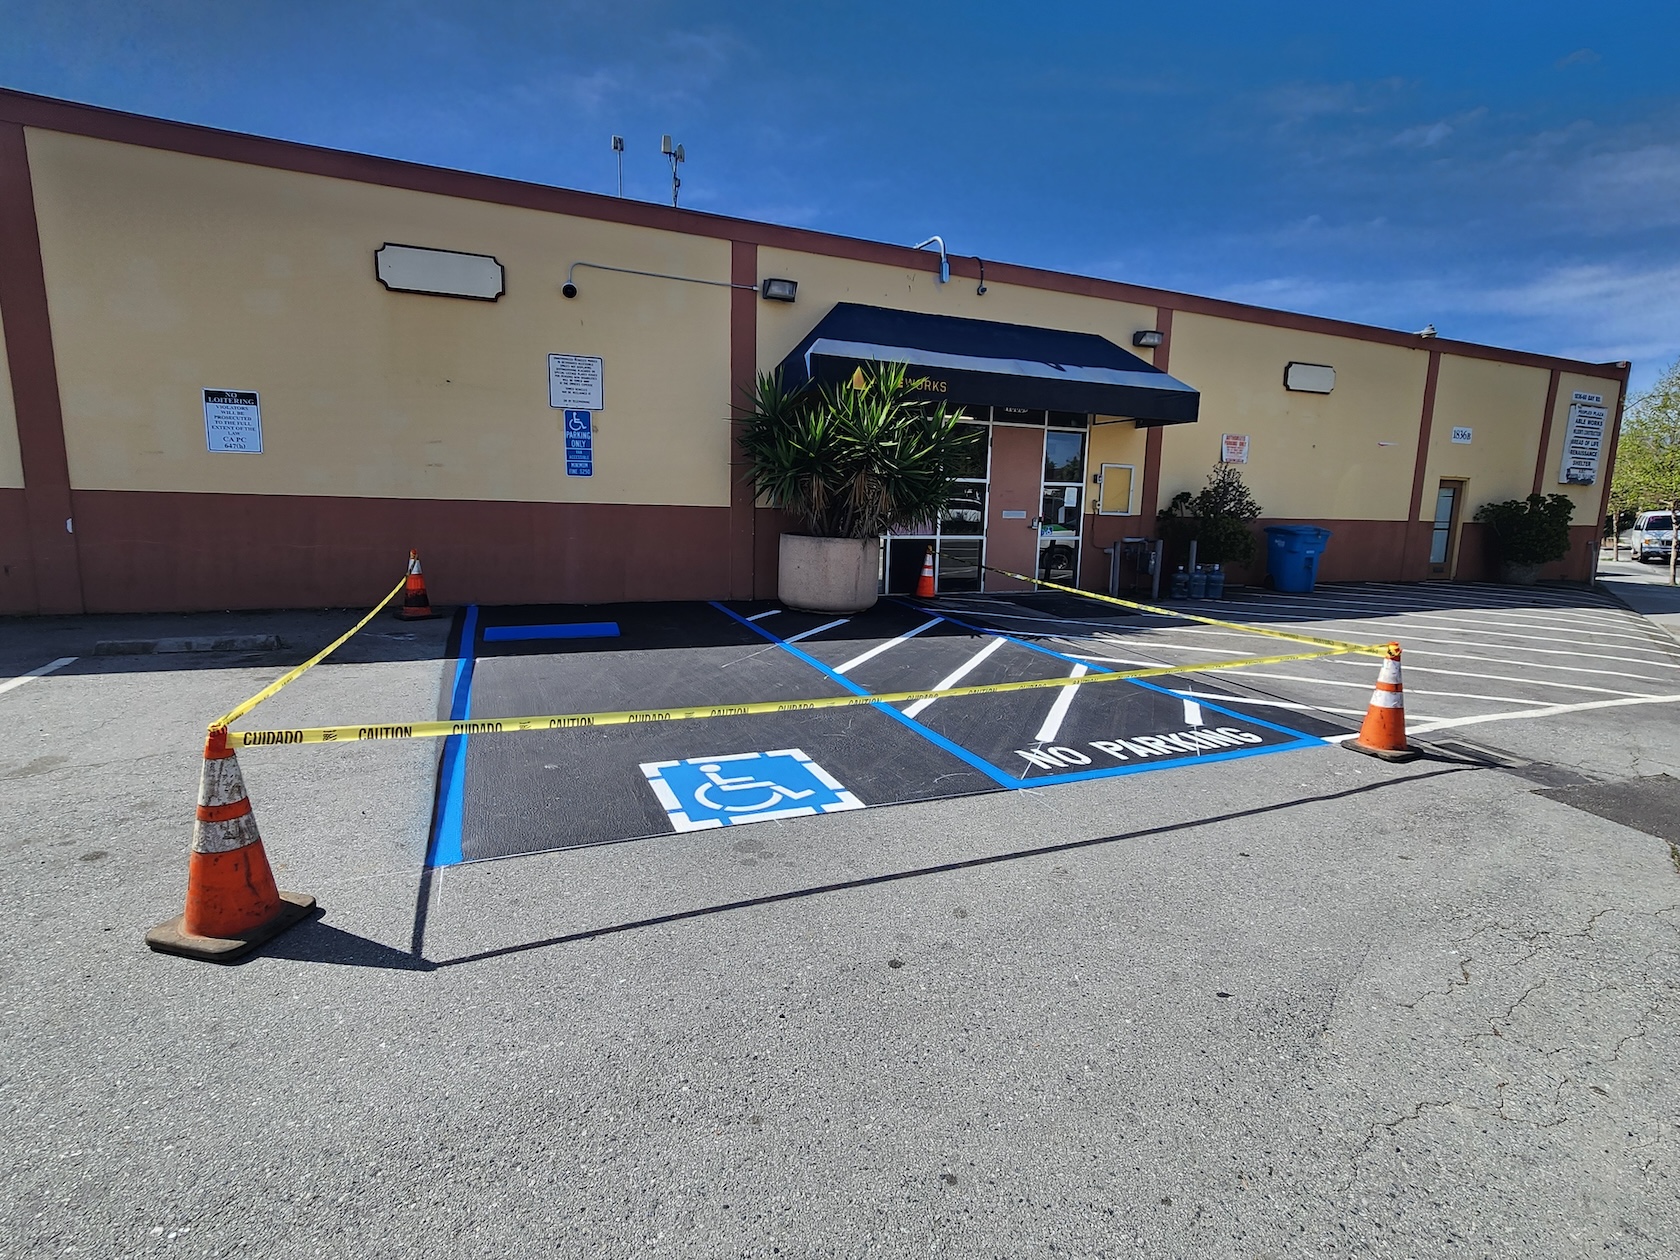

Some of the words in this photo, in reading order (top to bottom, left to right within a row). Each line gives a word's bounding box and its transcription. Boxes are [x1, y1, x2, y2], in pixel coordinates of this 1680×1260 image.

[208, 396, 255, 405] LOITERING
[566, 430, 591, 441] PARKING
[1453, 429, 1471, 440] 1836B
[570, 439, 587, 449] ONLY
[1570, 449, 1598, 457] RENAISSANCE
[243, 730, 304, 746] CUIDADO
[358, 726, 412, 741] CAUTION
[452, 722, 503, 735] CUIDADO
[550, 716, 595, 729] CAUTION
[1013, 745, 1093, 770] NO
[1088, 726, 1264, 761] PARKING
